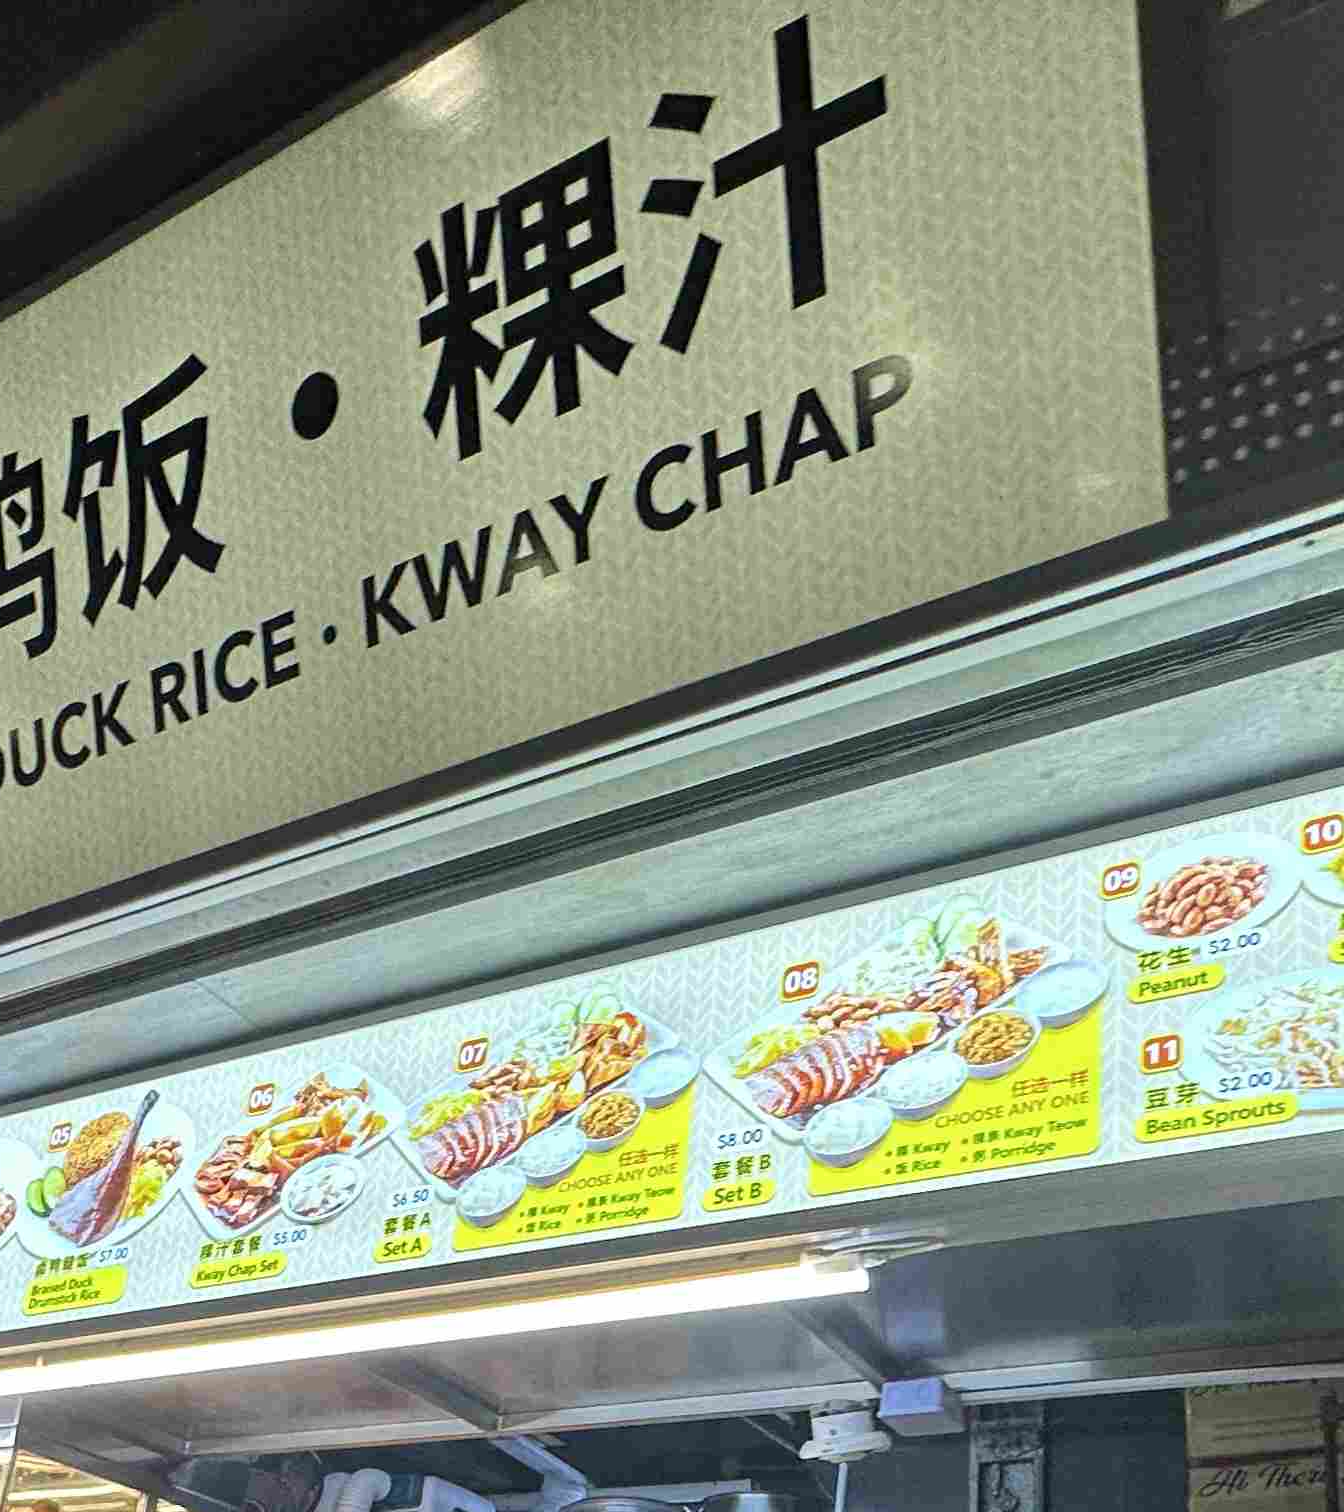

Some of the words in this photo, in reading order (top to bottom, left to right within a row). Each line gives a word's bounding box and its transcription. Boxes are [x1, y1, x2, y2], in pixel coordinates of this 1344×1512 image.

[414, 14, 887, 461] 粿汁
[149, 610, 300, 733] RICE
[361, 475, 608, 648] KWAY
[635, 354, 914, 531] CHAP
[1305, 820, 1342, 847] 10
[1103, 868, 1139, 891] 09
[1208, 932, 1261, 955] $2.00
[1136, 944, 1194, 971] 花生
[785, 968, 817, 990] 08
[1139, 971, 1209, 996] Peanut
[460, 1044, 486, 1064] 07
[1145, 1041, 1179, 1063] 11
[1218, 1071, 1273, 1093] $2.00
[250, 1089, 273, 1109] 06
[1144, 1081, 1200, 1109] 豆芽
[934, 1105, 1004, 1129] CHOOSE
[1008, 1097, 1047, 1117] ANY
[1050, 1090, 1089, 1108] ONE
[1146, 1109, 1198, 1135] Bean
[1204, 1100, 1287, 1128] Sprouts
[52, 1127, 73, 1144] 05
[1004, 1126, 1043, 1139] Kway
[991, 1141, 1057, 1160] Porridge
[911, 1159, 942, 1172] Rice
[558, 1174, 614, 1193] CHOOSE
[615, 1168, 647, 1184] ANY
[648, 1162, 679, 1178] ONE
[713, 1186, 744, 1204] Set
[750, 1182, 762, 1199] B
[384, 1239, 407, 1257] Set
[409, 1237, 423, 1253] A
[196, 1266, 224, 1283] Kway
[228, 1261, 257, 1278] Chap
[260, 1258, 279, 1273] Set
[69, 1276, 93, 1292] Duck
